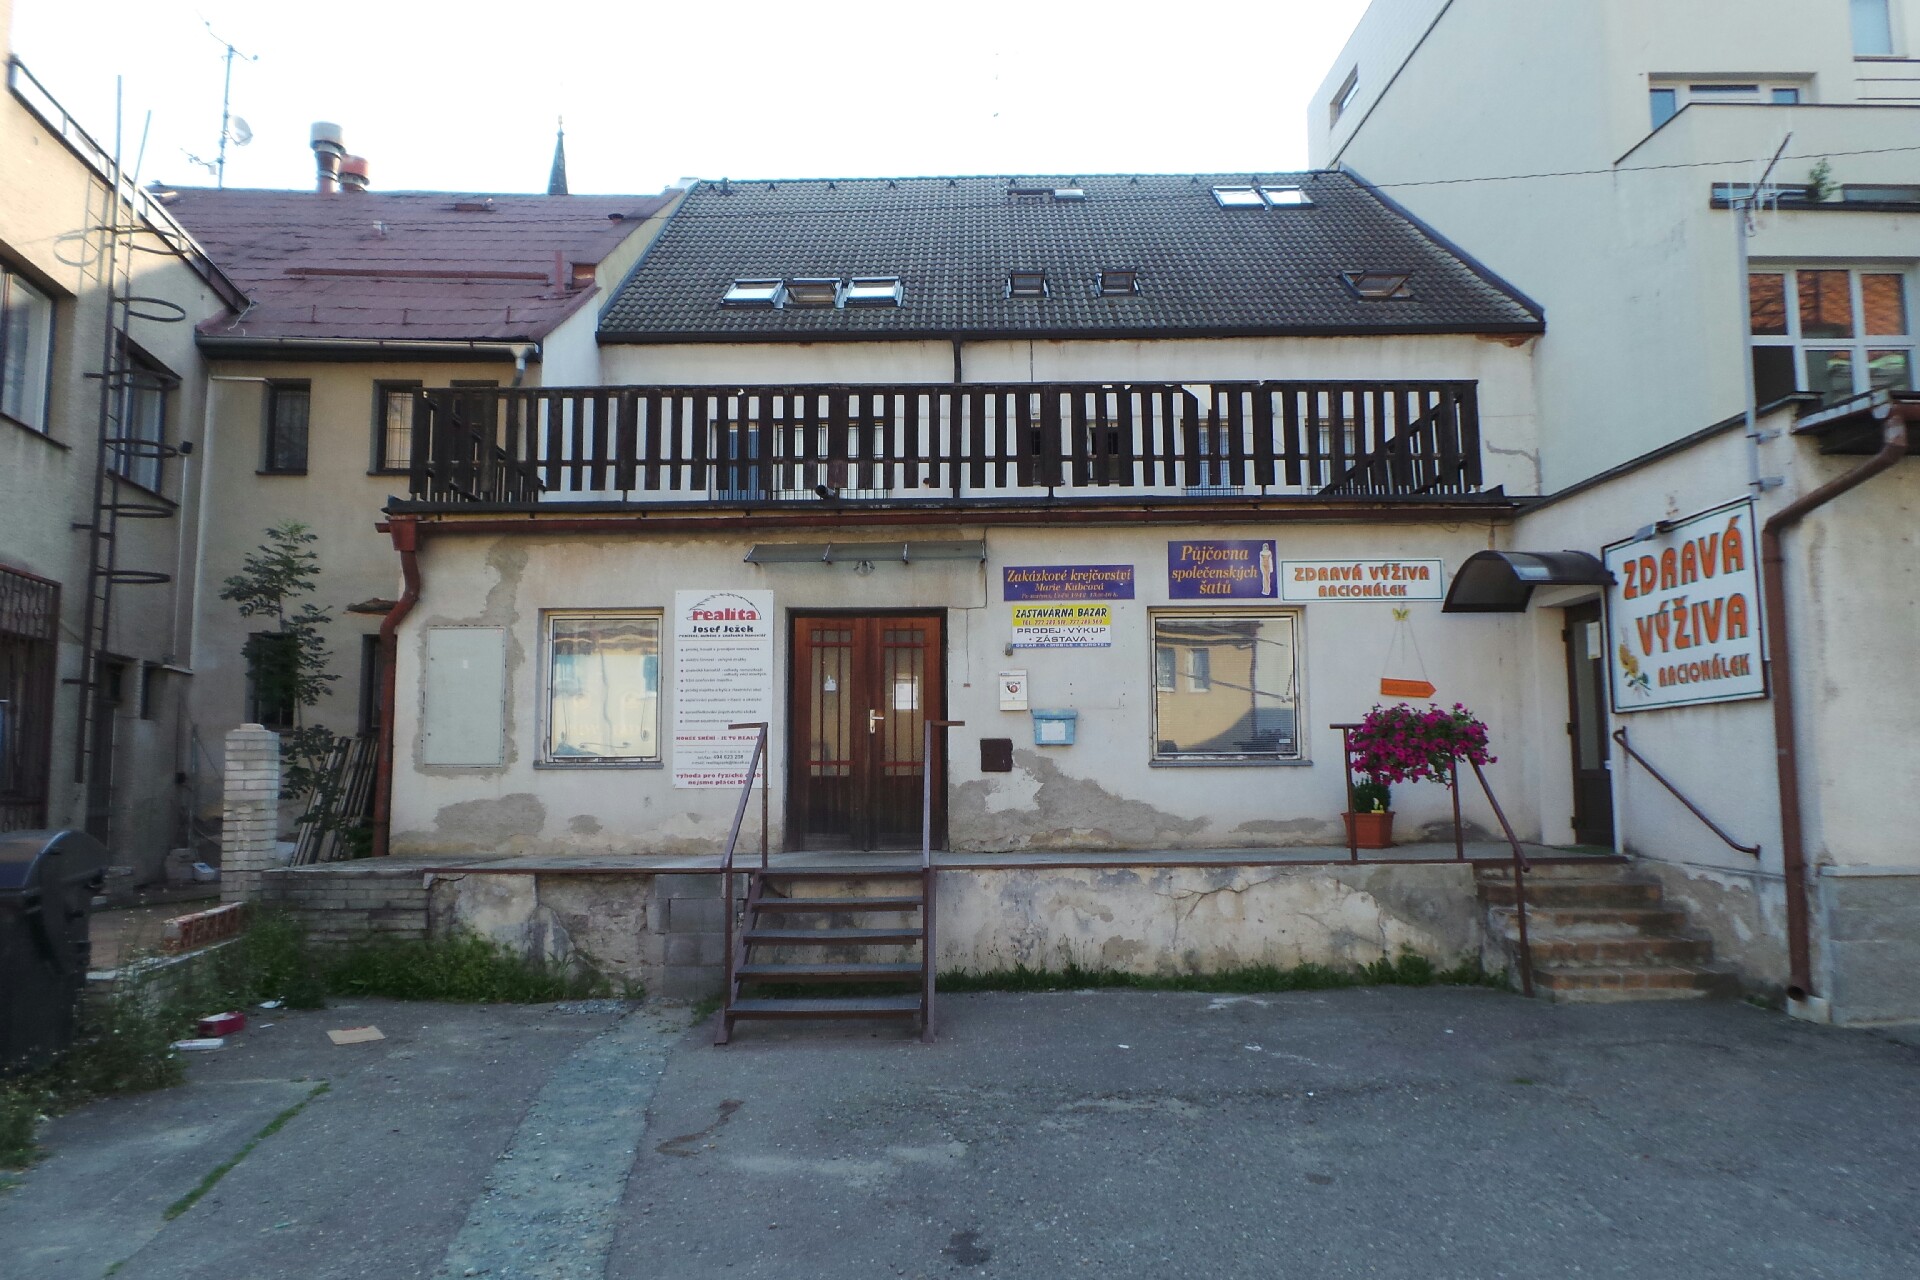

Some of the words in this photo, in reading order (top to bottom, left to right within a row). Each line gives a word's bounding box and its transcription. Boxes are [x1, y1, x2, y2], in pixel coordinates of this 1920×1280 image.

[1181, 545, 1249, 564] Půjčovna
[1623, 515, 1745, 600] ZDRAVÁ
[1007, 569, 1068, 582] Zakázkové
[1070, 569, 1131, 584] krejčovství
[1172, 565, 1258, 582] společenských
[1294, 563, 1363, 581] ZDRAVÁ
[1368, 563, 1430, 581] VÝŽIVA
[1035, 583, 1061, 591] Marie
[1200, 580, 1231, 594] šatů
[1318, 582, 1408, 597] RACIONÁLEK
[692, 607, 757, 621] realita
[1016, 607, 1074, 618] ZASTAVÁRNA
[1077, 608, 1107, 617] BAZAR
[693, 625, 721, 633] Josef
[723, 624, 754, 633] Ježek
[1067, 626, 1106, 634] VÝKUP
[1635, 593, 1748, 656] VÝŽIVA
[1035, 635, 1087, 643] ZÁSTAVA
[1659, 653, 1750, 687] RACIONÁLEK
